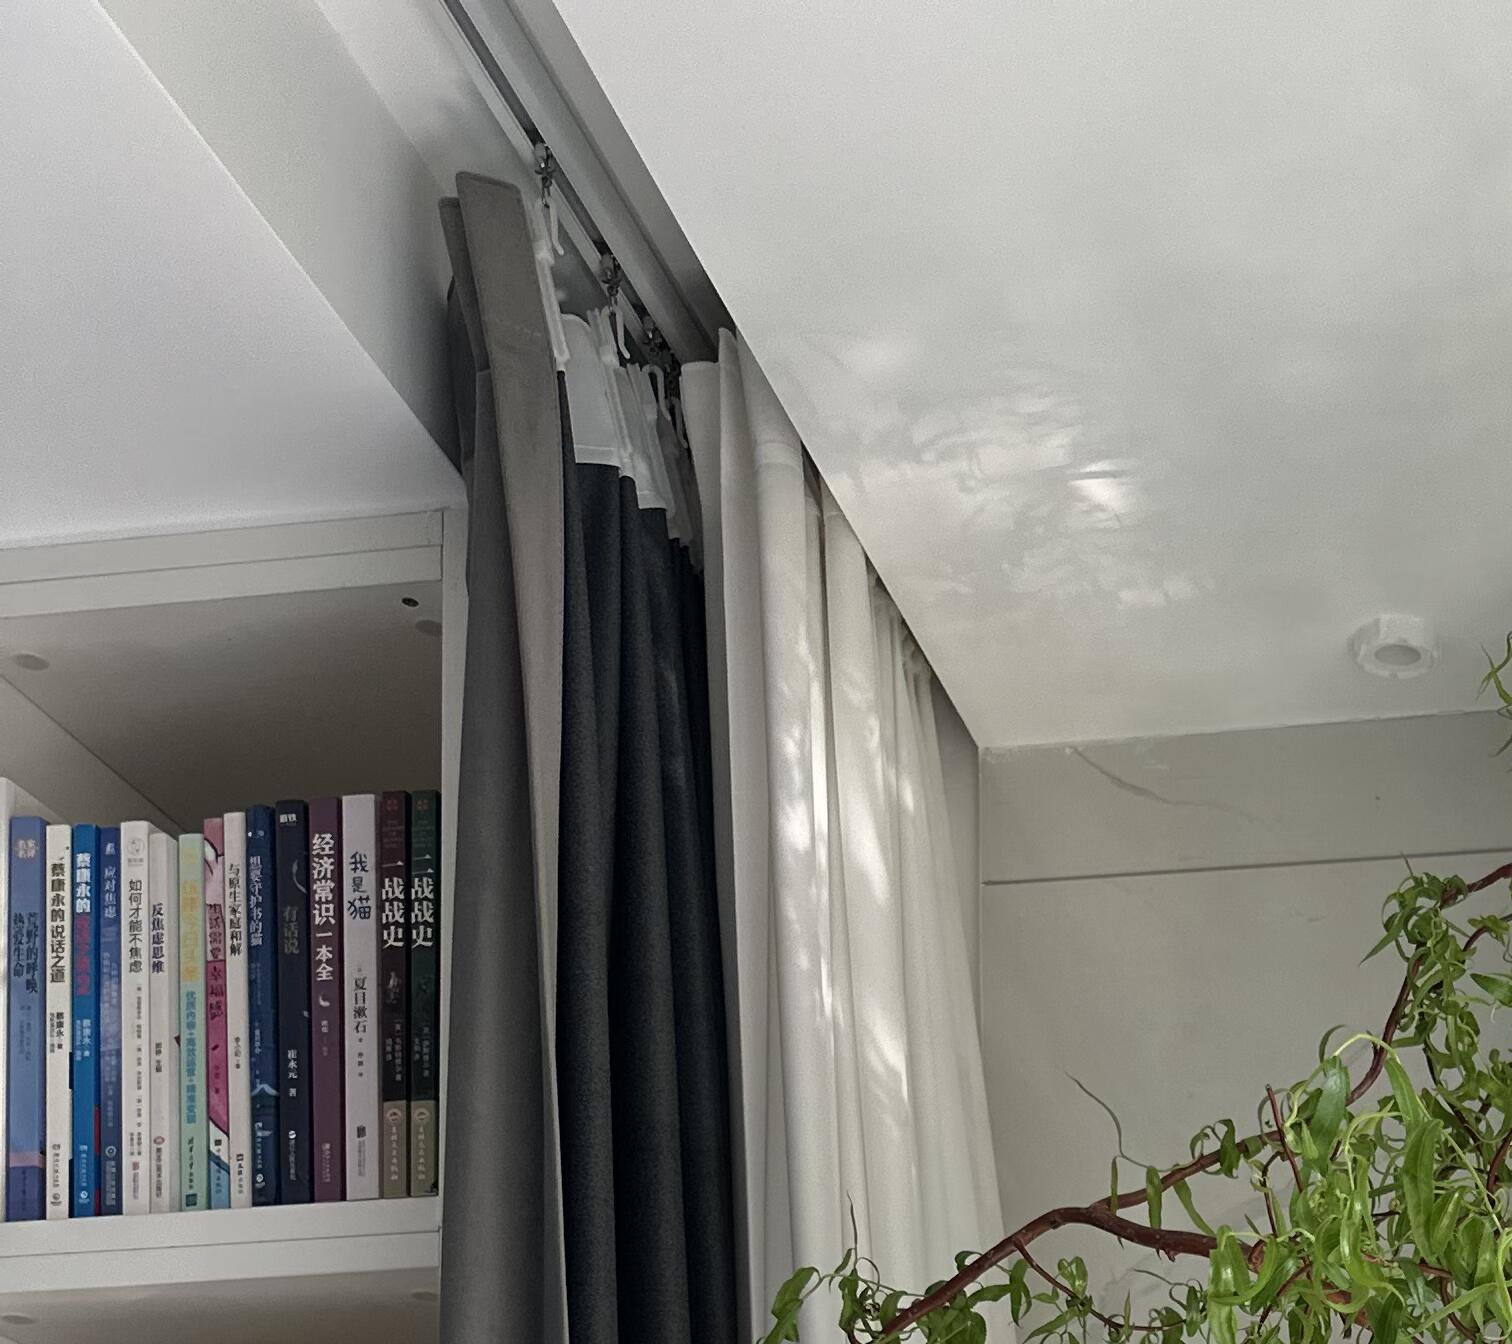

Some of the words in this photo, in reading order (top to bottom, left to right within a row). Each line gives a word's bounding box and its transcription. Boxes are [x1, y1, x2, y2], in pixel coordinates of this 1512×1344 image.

[75, 853, 91, 914] 蔡康永的
[103, 866, 117, 919] 应对焦虑
[229, 864, 243, 958] 与原生家庭和解
[312, 833, 335, 981] 经济常识一本全
[347, 851, 371, 920] 我是猫
[381, 861, 405, 949] 一战战史
[411, 854, 434, 948] 二战战史
[13, 912, 25, 977] 热爱生命
[26, 912, 38, 993] 荒野的呼唤
[50, 863, 66, 983] 蔡康永的说话之道
[128, 880, 143, 974] 如何才能不焦虑
[152, 902, 165, 974] 反焦虑思维
[283, 906, 299, 954] 有话说
[353, 976, 368, 1034] 夏目漱石
[287, 1050, 298, 1079] 崔永元
